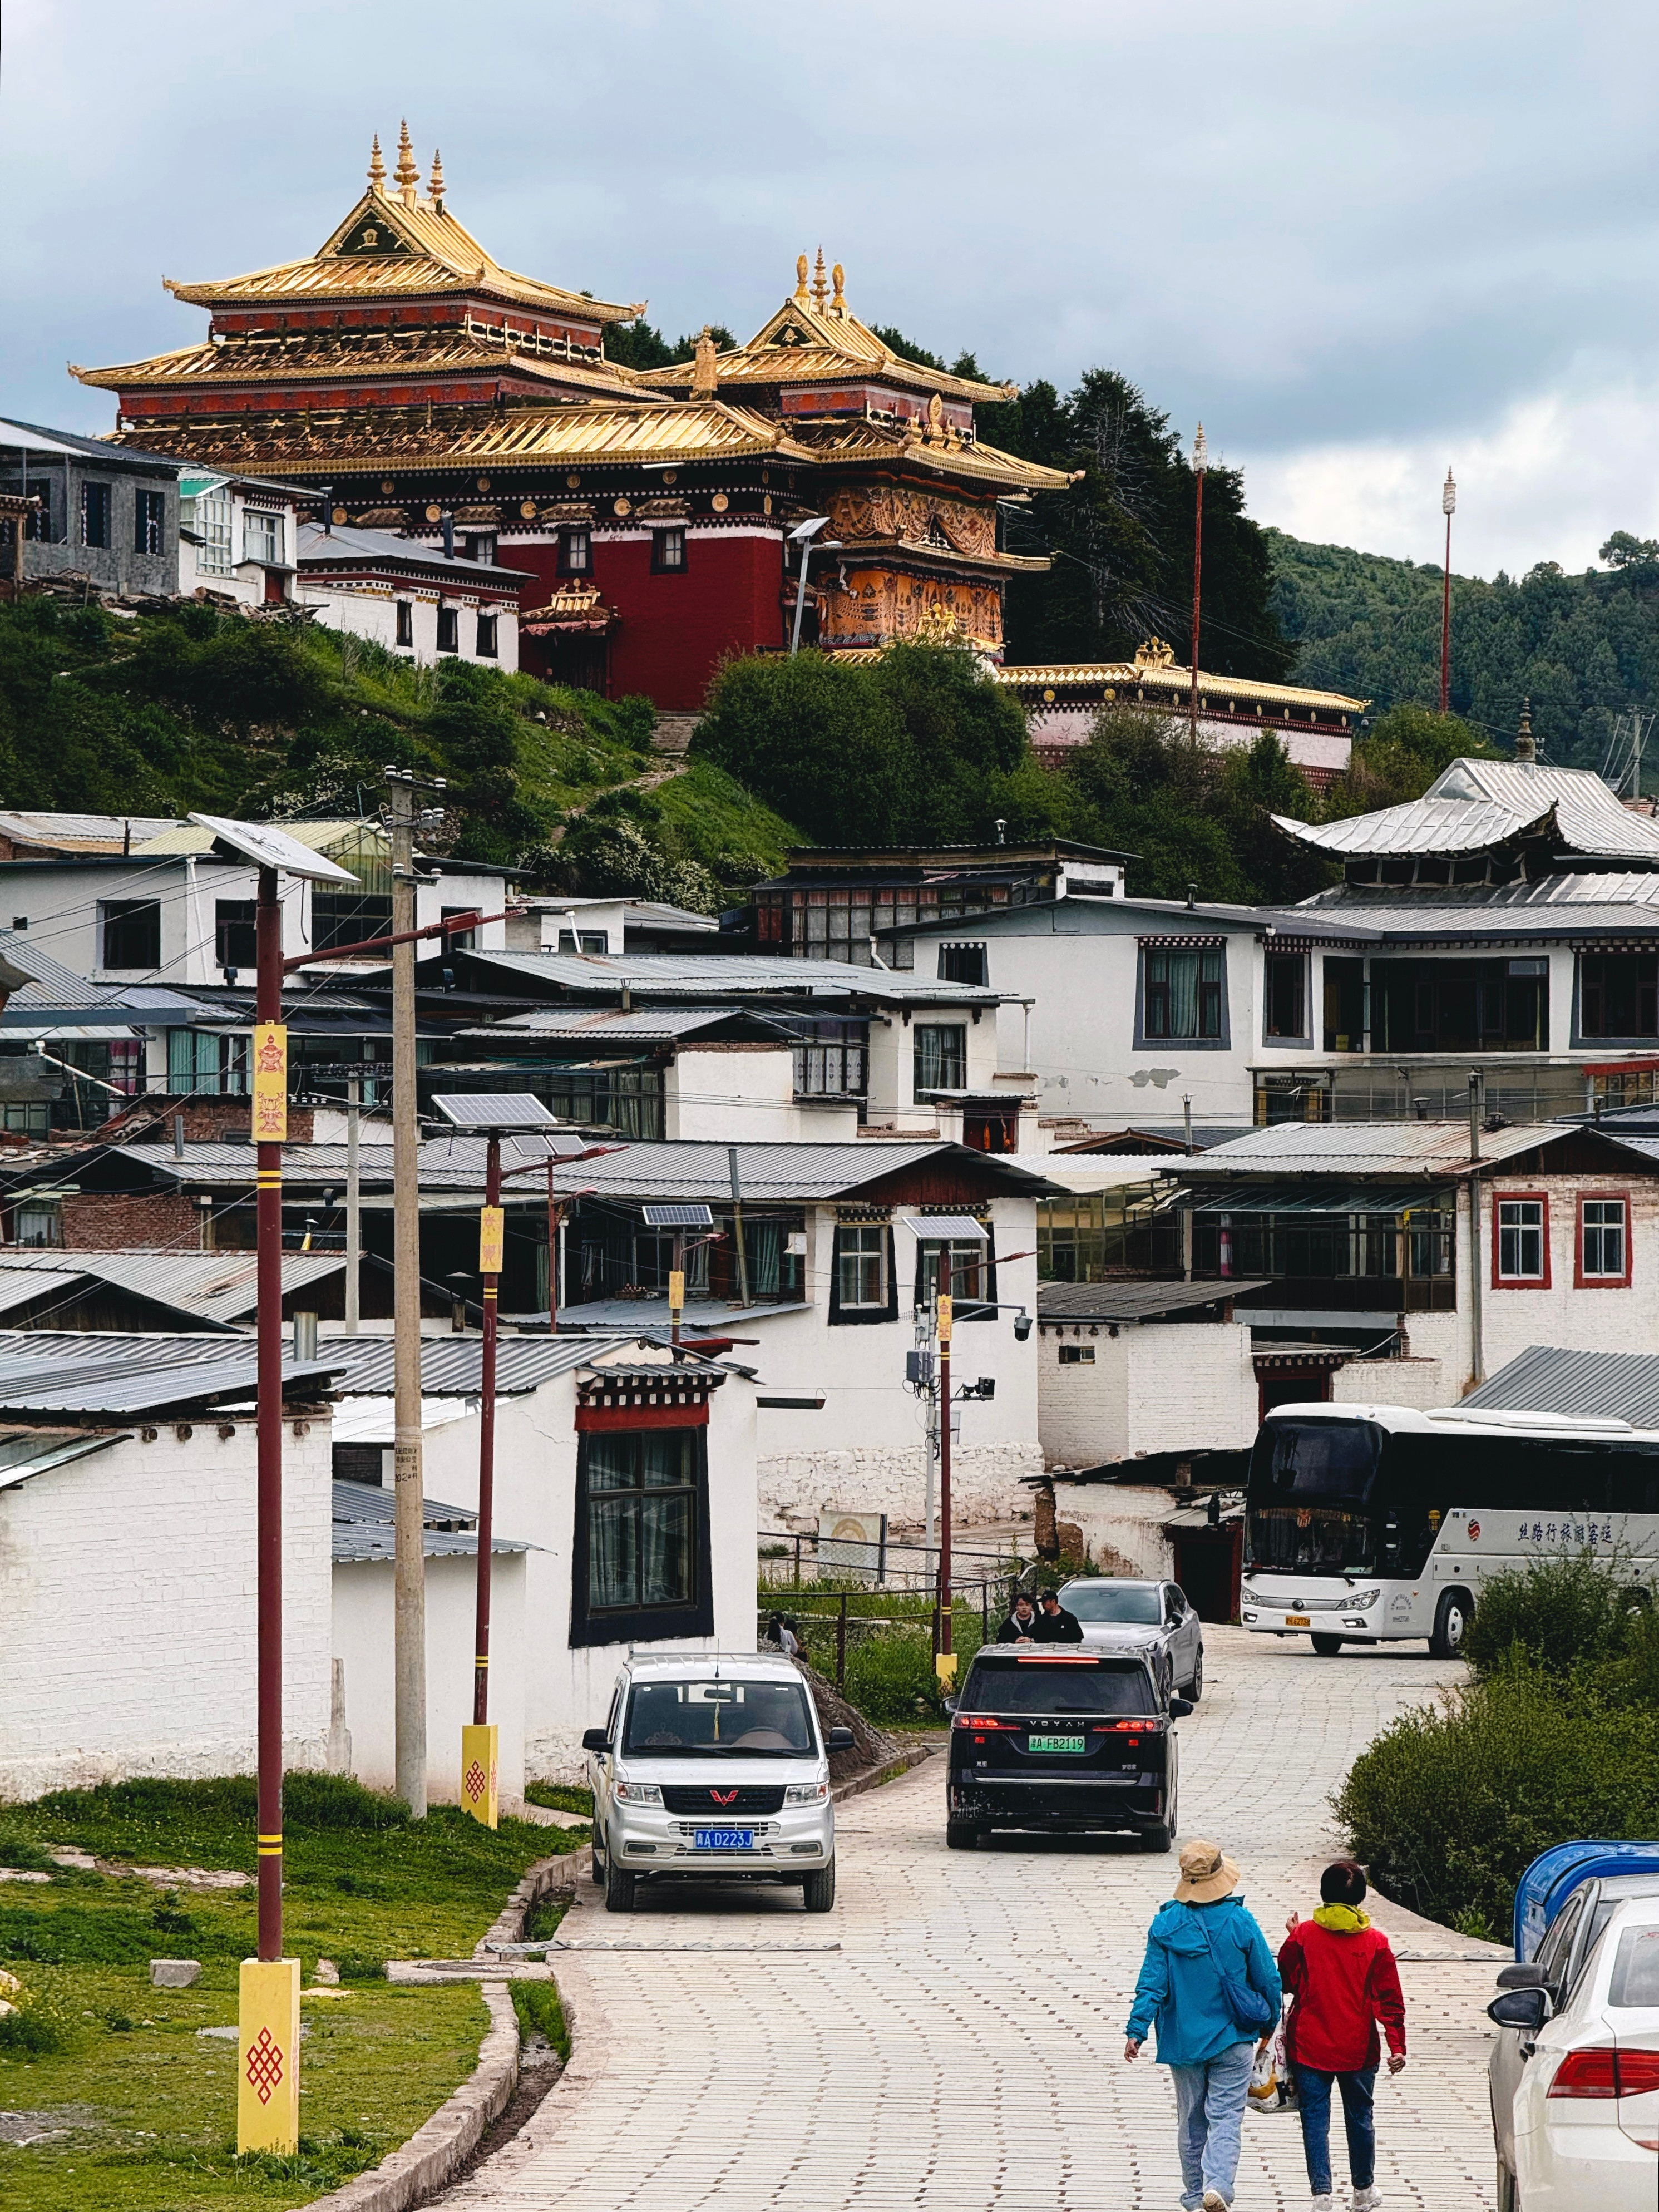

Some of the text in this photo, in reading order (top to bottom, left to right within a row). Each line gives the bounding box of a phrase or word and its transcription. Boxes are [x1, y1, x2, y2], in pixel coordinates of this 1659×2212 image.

[1517, 1521, 1613, 1545] 丝路行旅游客运
